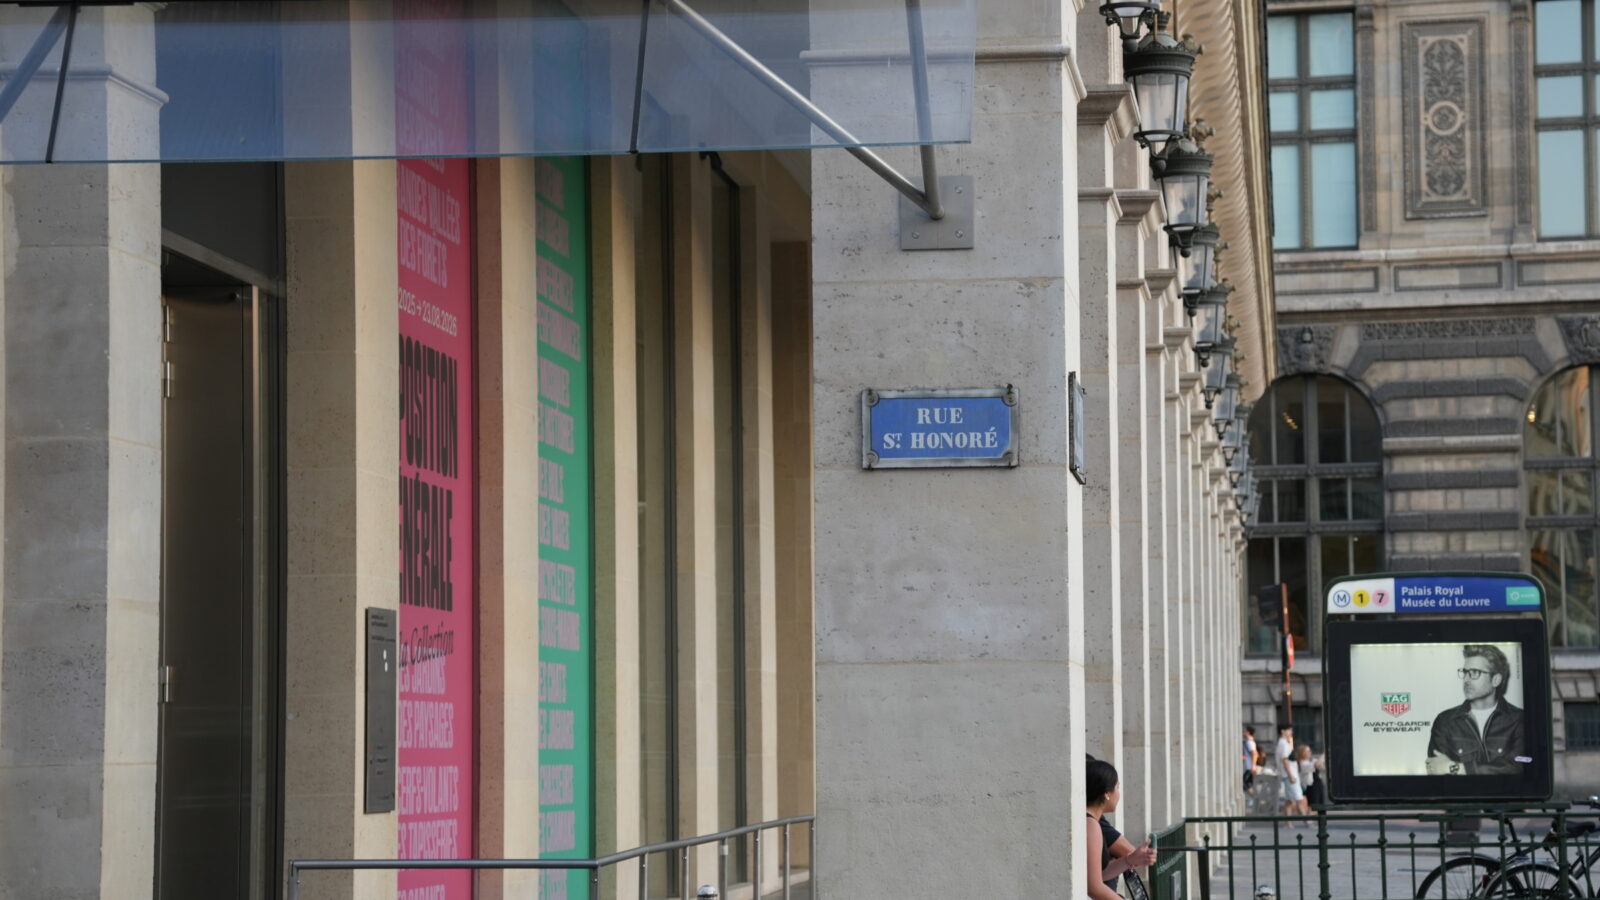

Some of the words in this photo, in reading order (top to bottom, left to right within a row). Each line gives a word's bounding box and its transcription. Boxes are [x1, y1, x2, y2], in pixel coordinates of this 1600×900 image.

[917, 407, 964, 425] RUE
[910, 426, 998, 449] HONORÉ
[1357, 593, 1364, 604] 1
[1377, 592, 1385, 604] 7
[1401, 586, 1432, 596] Palais
[1435, 585, 1464, 597] Royal
[1402, 597, 1436, 607] Musée
[1439, 597, 1452, 607] du
[1455, 597, 1490, 607] Louvre
[410, 621, 454, 665] Collection
[1385, 694, 1408, 703] TAG
[414, 701, 454, 749] PAYSAGES
